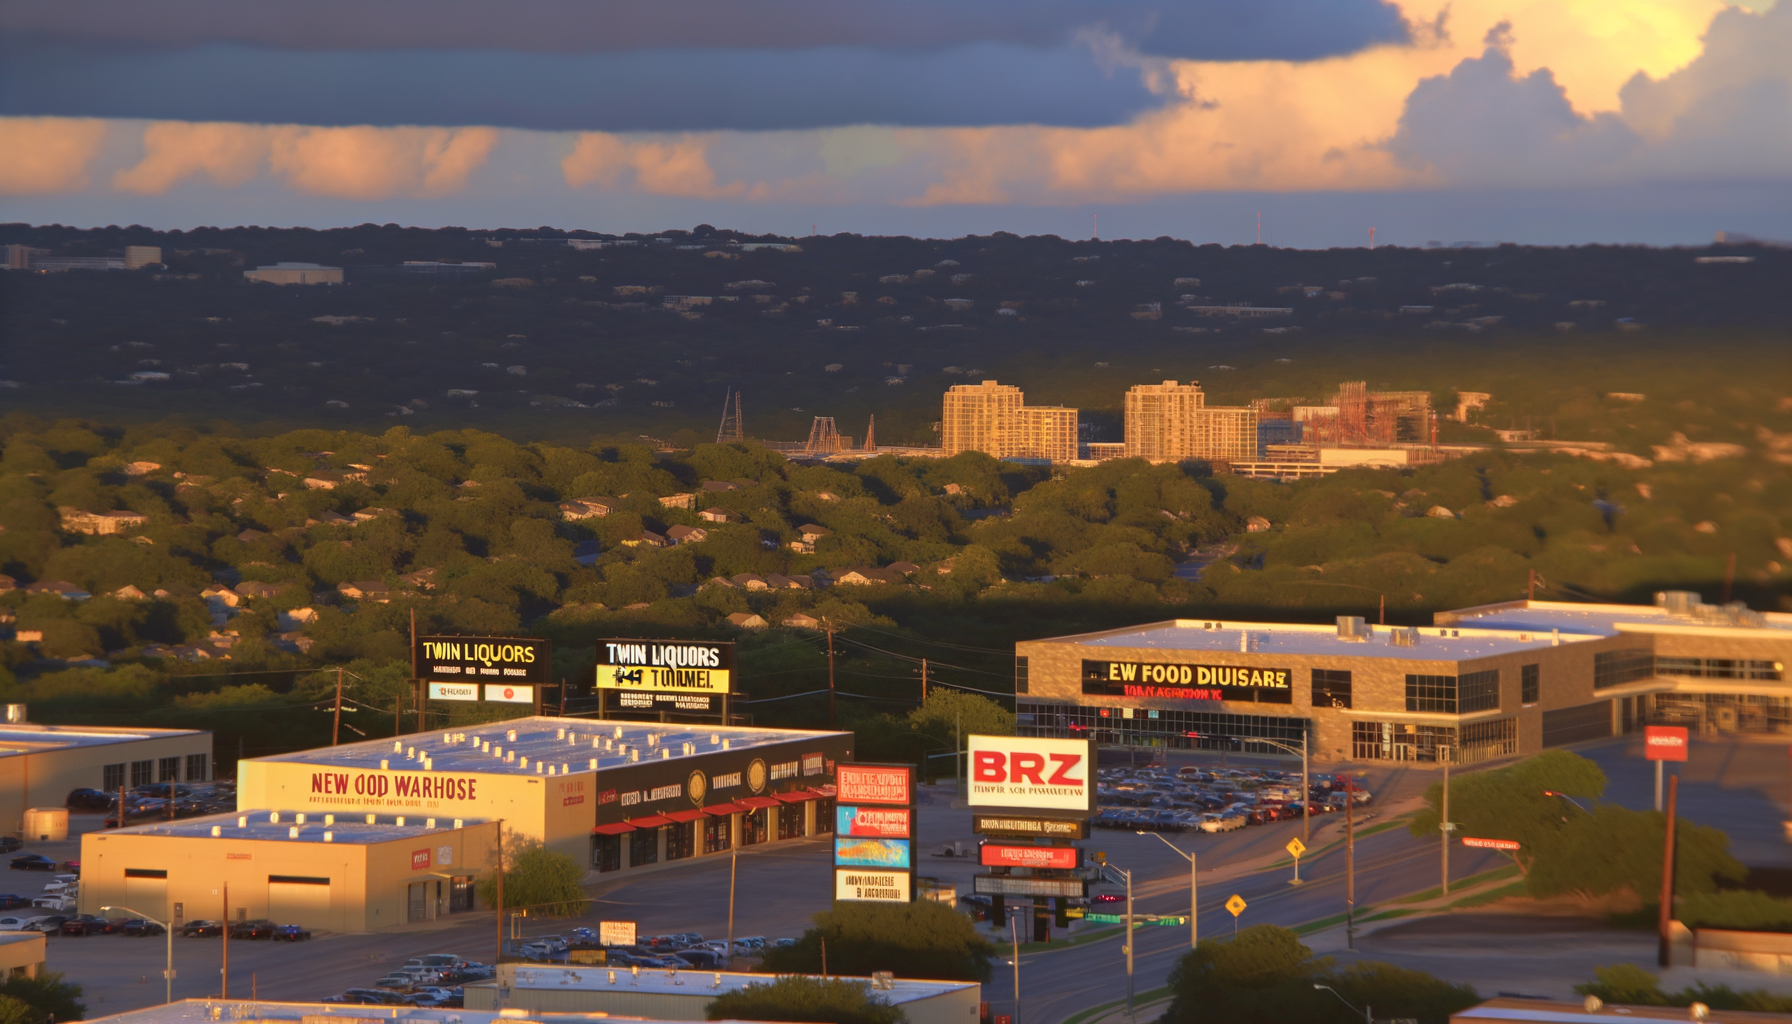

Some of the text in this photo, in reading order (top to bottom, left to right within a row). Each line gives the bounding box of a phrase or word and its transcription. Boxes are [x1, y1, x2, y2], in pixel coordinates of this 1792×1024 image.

[423, 642, 535, 667] TWIN LIQUORS
[606, 643, 720, 669] TWIN LIQUORS
[1109, 663, 1137, 681] EW
[1142, 665, 1192, 684] FOOD
[973, 750, 1084, 786] BRZ
[312, 773, 349, 795] NEW
[394, 775, 477, 801] WARHOSE
